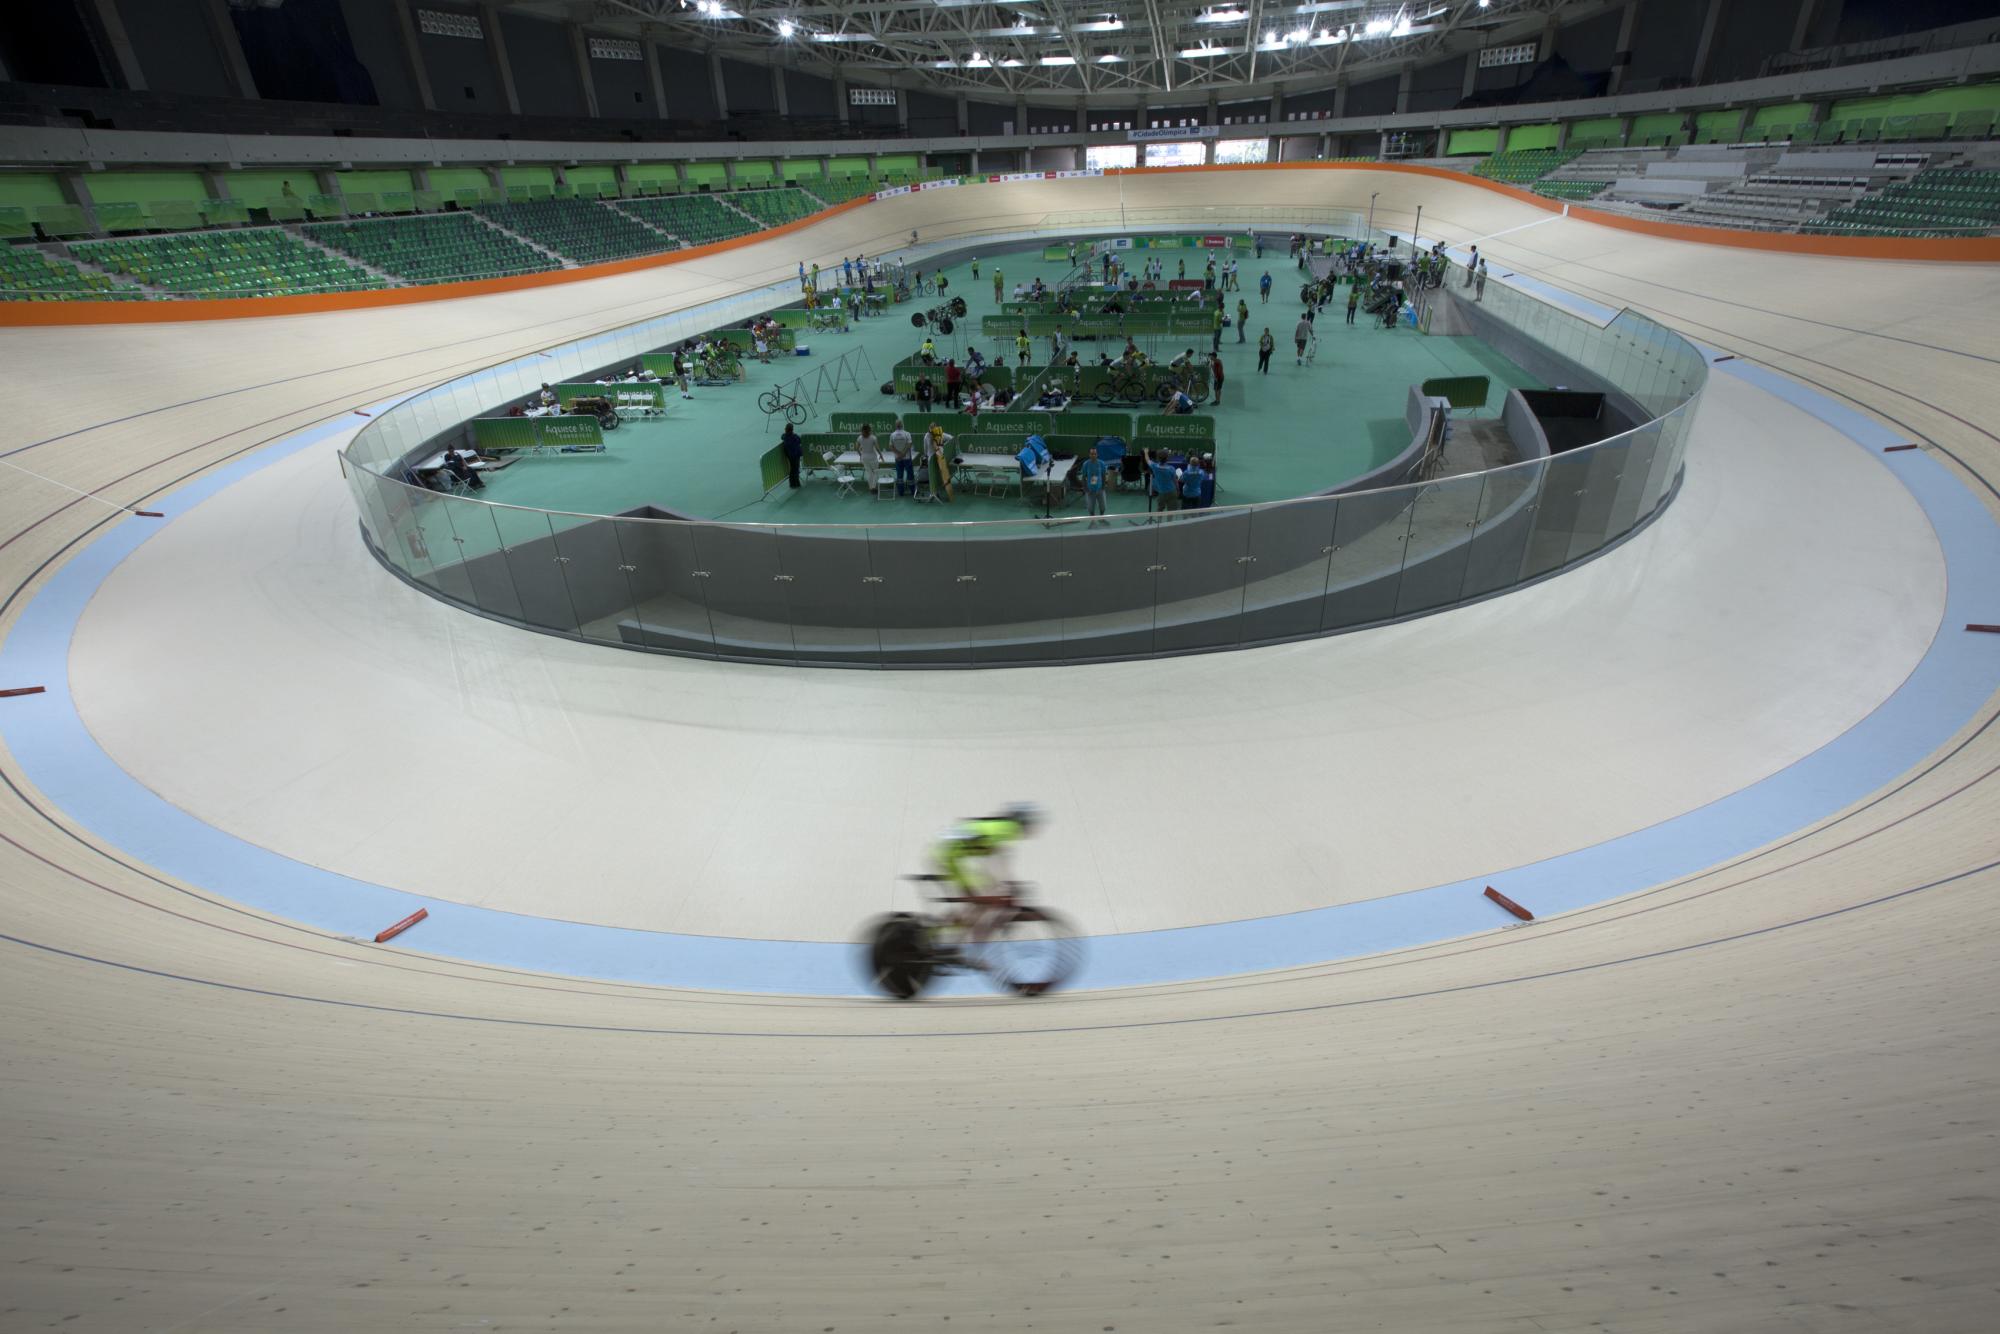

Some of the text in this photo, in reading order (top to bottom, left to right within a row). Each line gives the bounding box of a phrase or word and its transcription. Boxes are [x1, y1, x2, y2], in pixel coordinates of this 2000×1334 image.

[545, 424, 578, 436] Aquece
[579, 423, 594, 433] Rio
[986, 421, 1044, 434] Aquece Rio
[1145, 423, 1207, 437] Aquece Rio
[808, 442, 847, 455] Aquece
